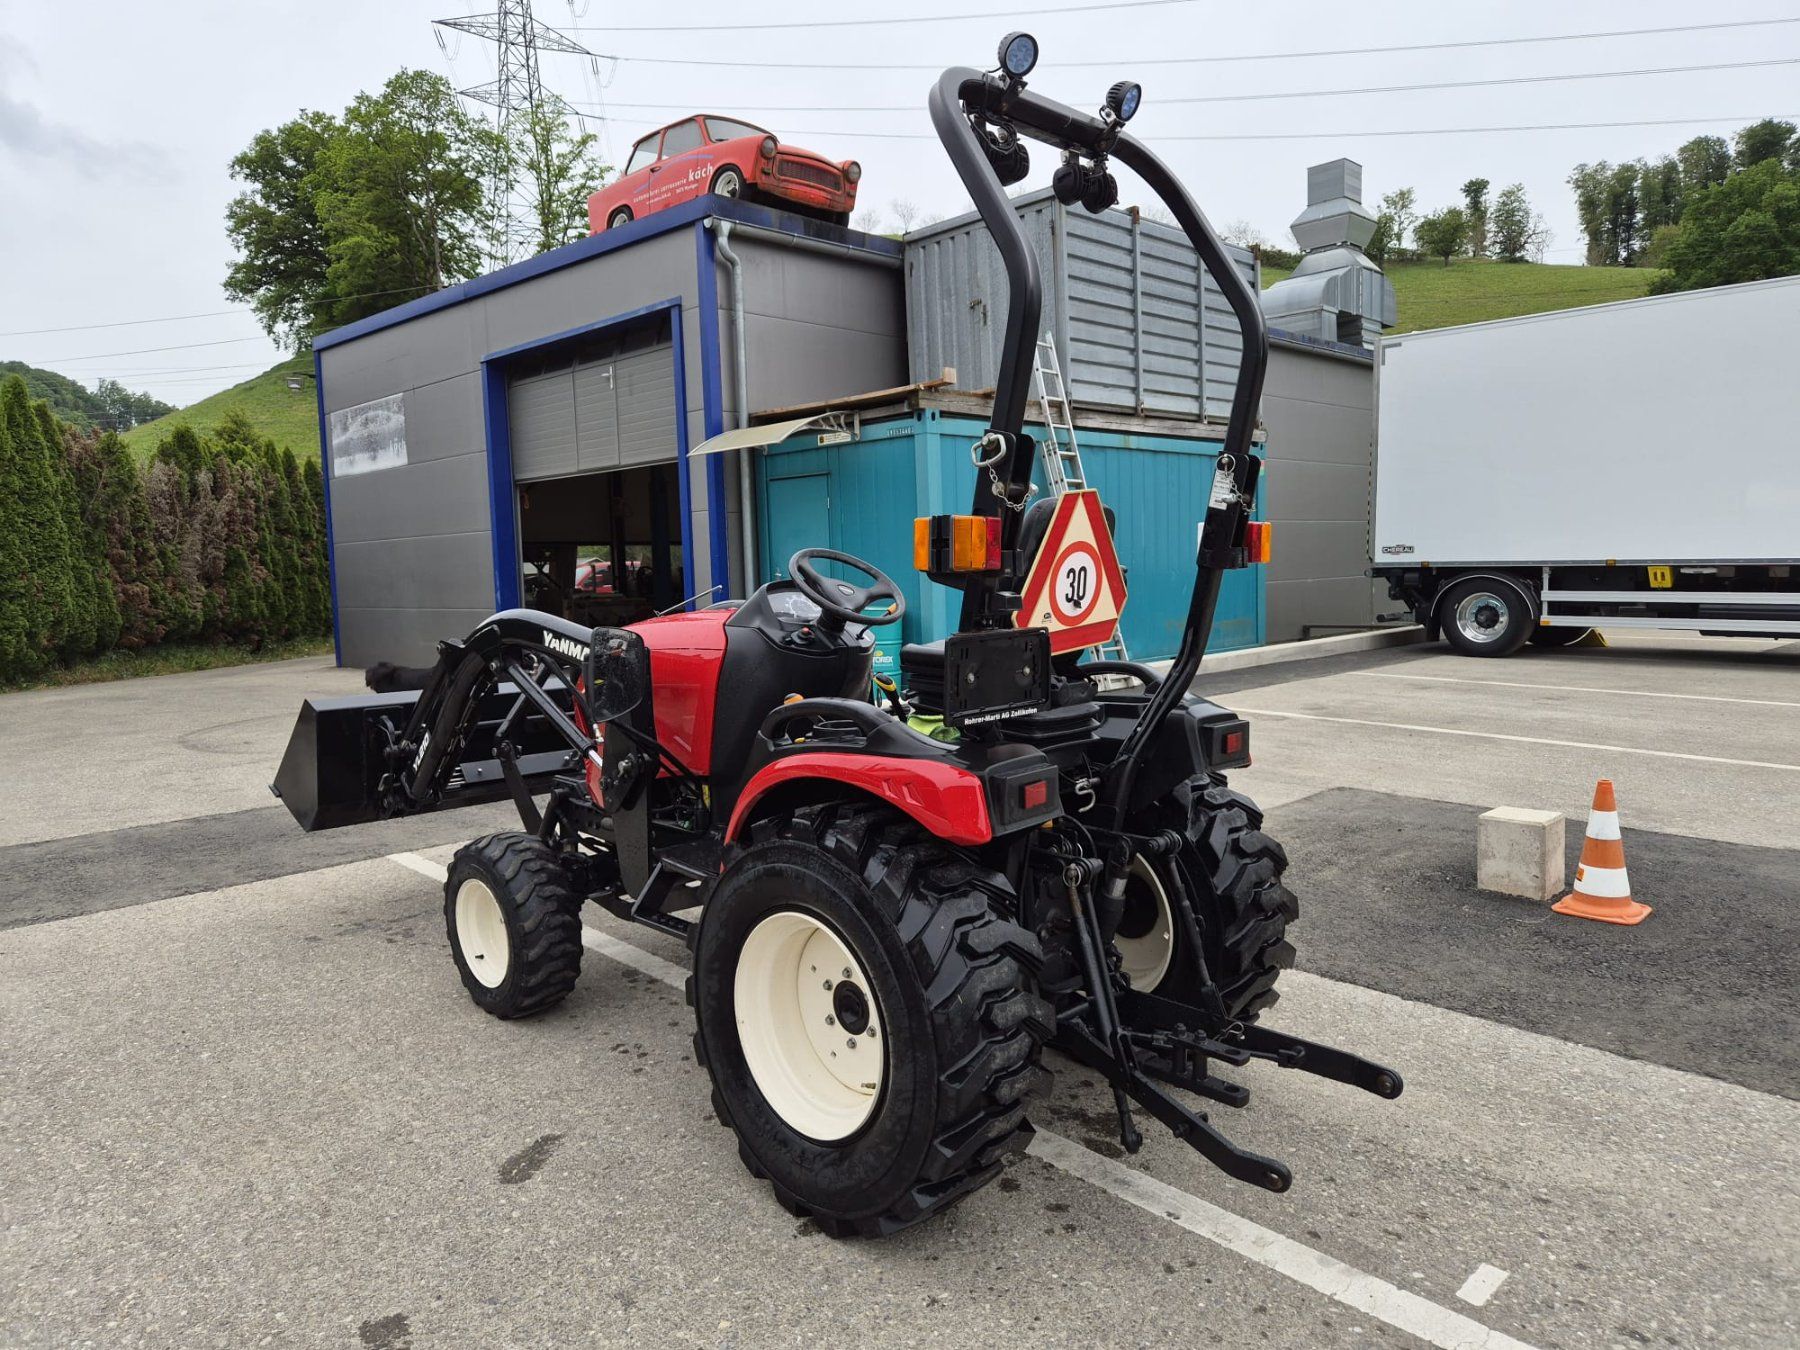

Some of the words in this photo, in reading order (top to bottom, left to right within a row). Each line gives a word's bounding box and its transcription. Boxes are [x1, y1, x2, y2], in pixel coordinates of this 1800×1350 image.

[1065, 565, 1087, 604] 30
[964, 713, 1001, 725] Rohrer-Marti
[1001, 711, 1010, 719] AG
